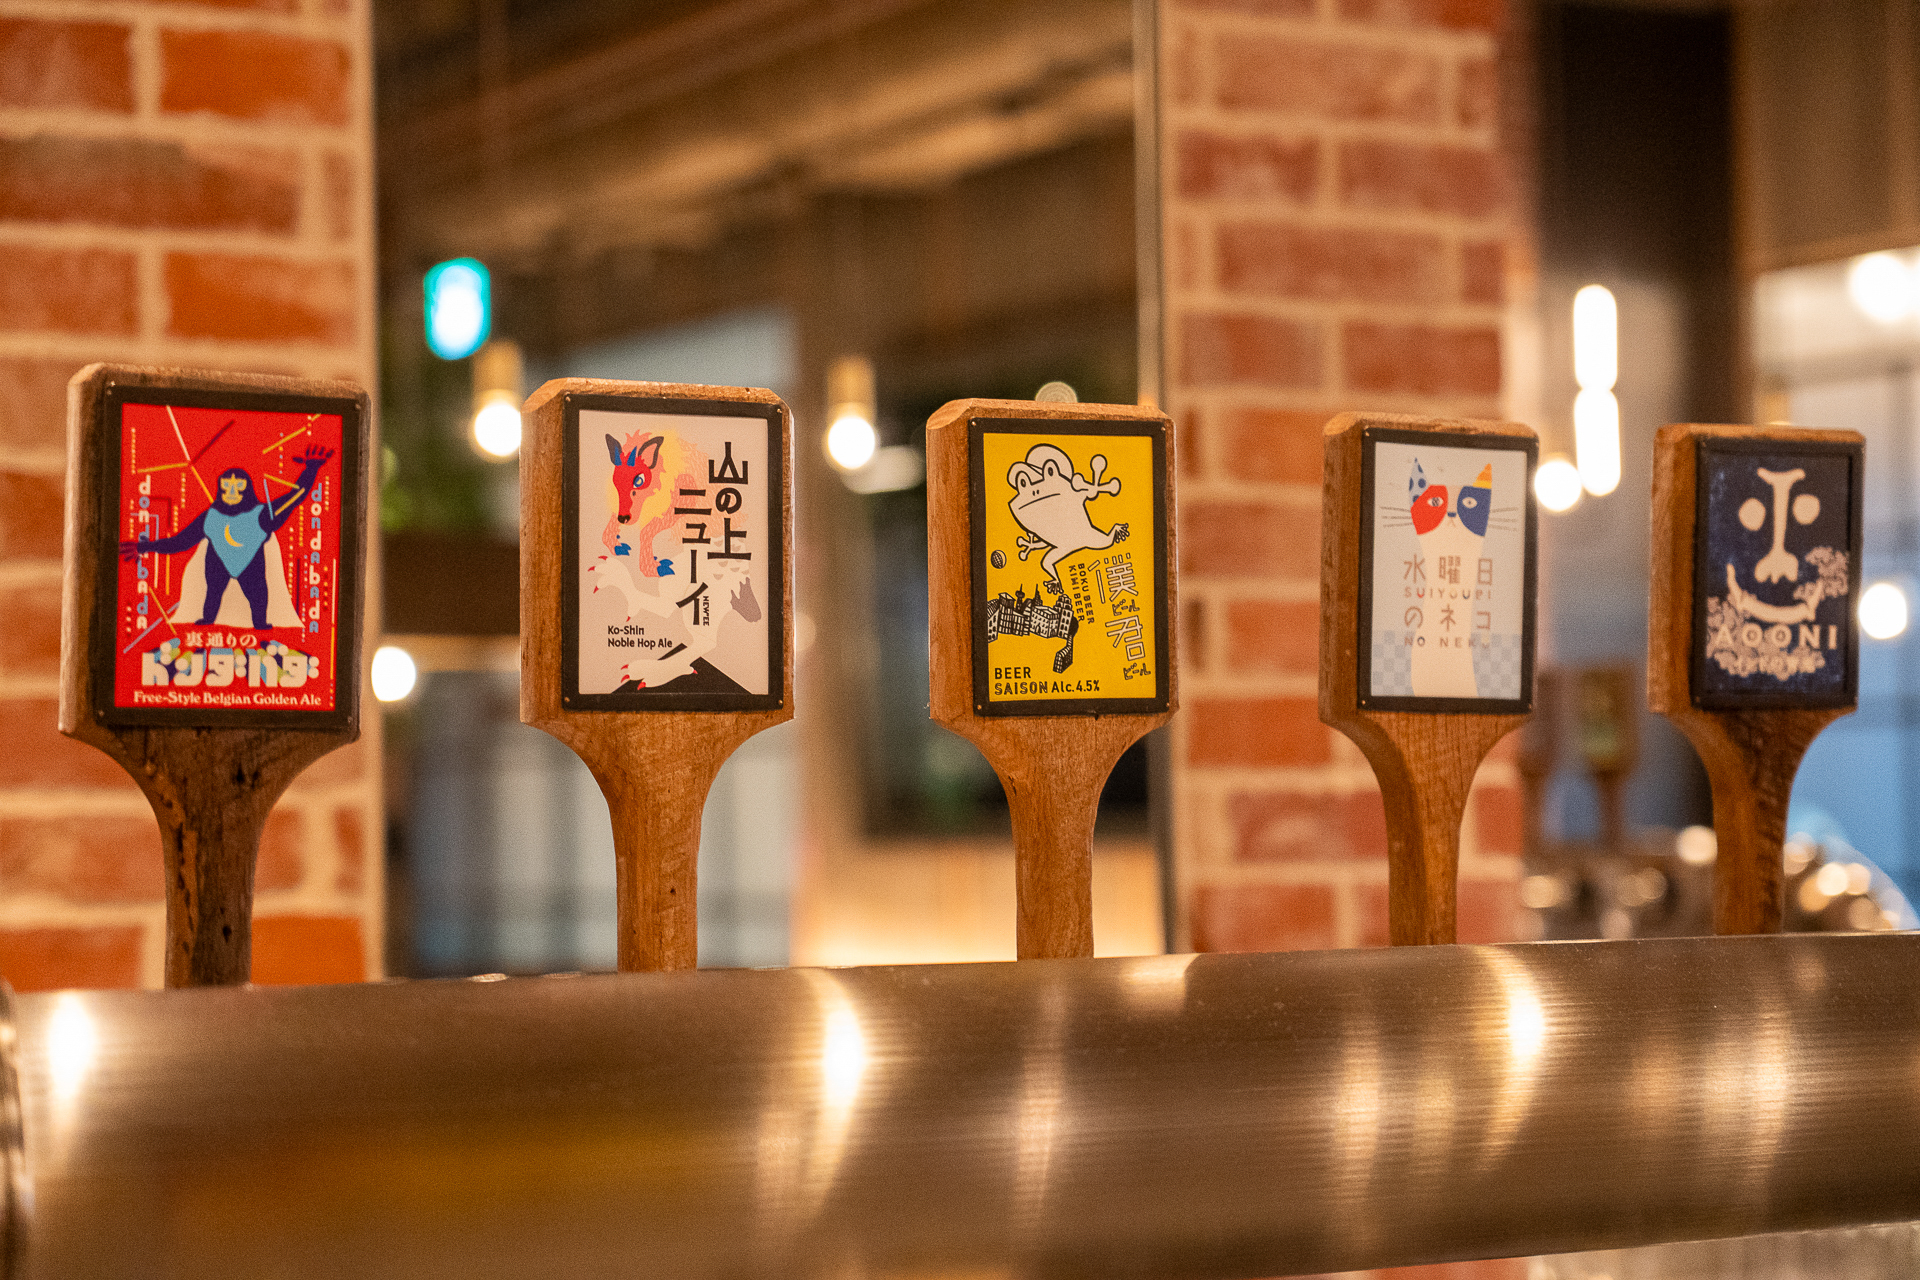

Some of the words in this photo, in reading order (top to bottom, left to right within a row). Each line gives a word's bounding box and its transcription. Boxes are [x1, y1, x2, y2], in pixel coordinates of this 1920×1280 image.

[707, 441, 752, 561] 山の上
[674, 488, 712, 626] ニューイ
[1403, 554, 1493, 586] 水曜日
[1069, 564, 1080, 591] KIMI
[1078, 563, 1089, 592] BOKU
[1073, 593, 1085, 622] BEER
[1083, 594, 1095, 625] BEER
[607, 624, 645, 636] Ko-Shin
[607, 637, 635, 648] Noble
[637, 638, 656, 650] Hop
[657, 638, 673, 648] Ale
[1716, 623, 1838, 650] AOONI
[994, 666, 1031, 680] BEER
[134, 690, 201, 706] Free-Style
[203, 692, 251, 706] Belgian
[253, 692, 299, 705] Golden
[300, 694, 322, 706] Ale
[994, 681, 1048, 696] SAISON
